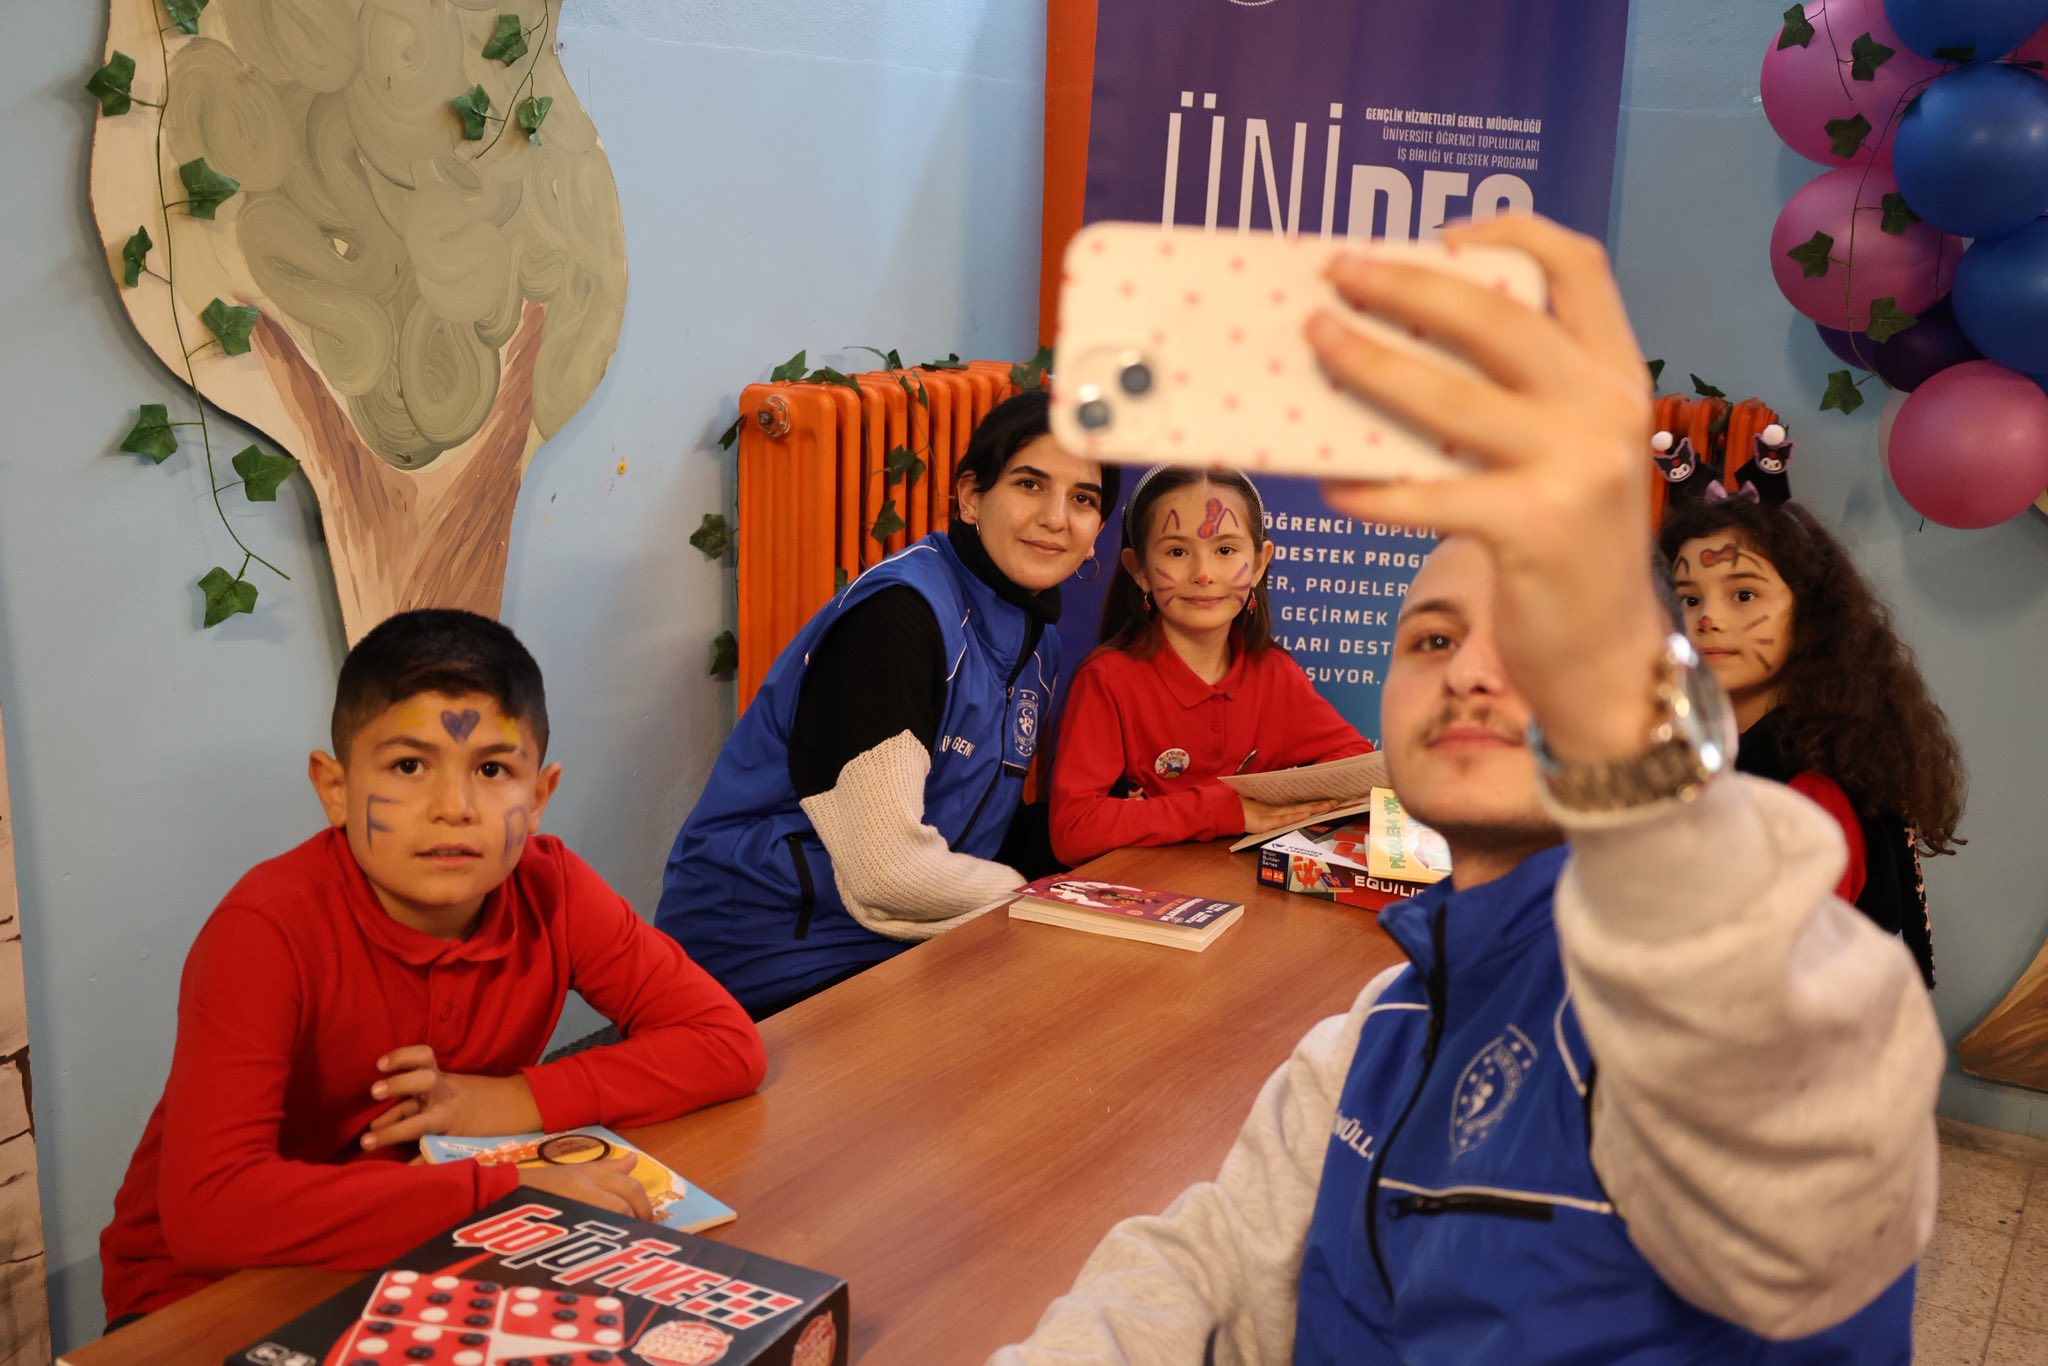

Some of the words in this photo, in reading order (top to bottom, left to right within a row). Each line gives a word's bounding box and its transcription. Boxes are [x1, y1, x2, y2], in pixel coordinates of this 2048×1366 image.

[1366, 107, 1403, 123] GENÇLİK
[1405, 109, 1456, 126] HİZMETLERİ
[1457, 115, 1484, 129] GENEL
[1486, 116, 1541, 134] MÜDÜRLÜĞÜ
[1383, 126, 1433, 143] ÜNİVERSİTE
[1436, 130, 1475, 147] ÖĞRENCİ
[1478, 135, 1540, 152] TOPLULUKLARI
[1397, 146, 1407, 163] İŞ
[1409, 148, 1441, 163] BİRLİĞİ
[1443, 152, 1454, 164] VE
[1456, 153, 1489, 167] DESTEK
[1492, 155, 1538, 171] PROGRAMI
[1263, 511, 1352, 534] ÖĞRENCİ
[1275, 546, 1355, 564] DESTEK
[1365, 551, 1425, 568] PROG
[1306, 578, 1408, 598] PROJELER
[1281, 605, 1387, 626] GEÇİRMEK
[1340, 639, 1396, 655] DEST
[951, 736, 976, 760] GEN
